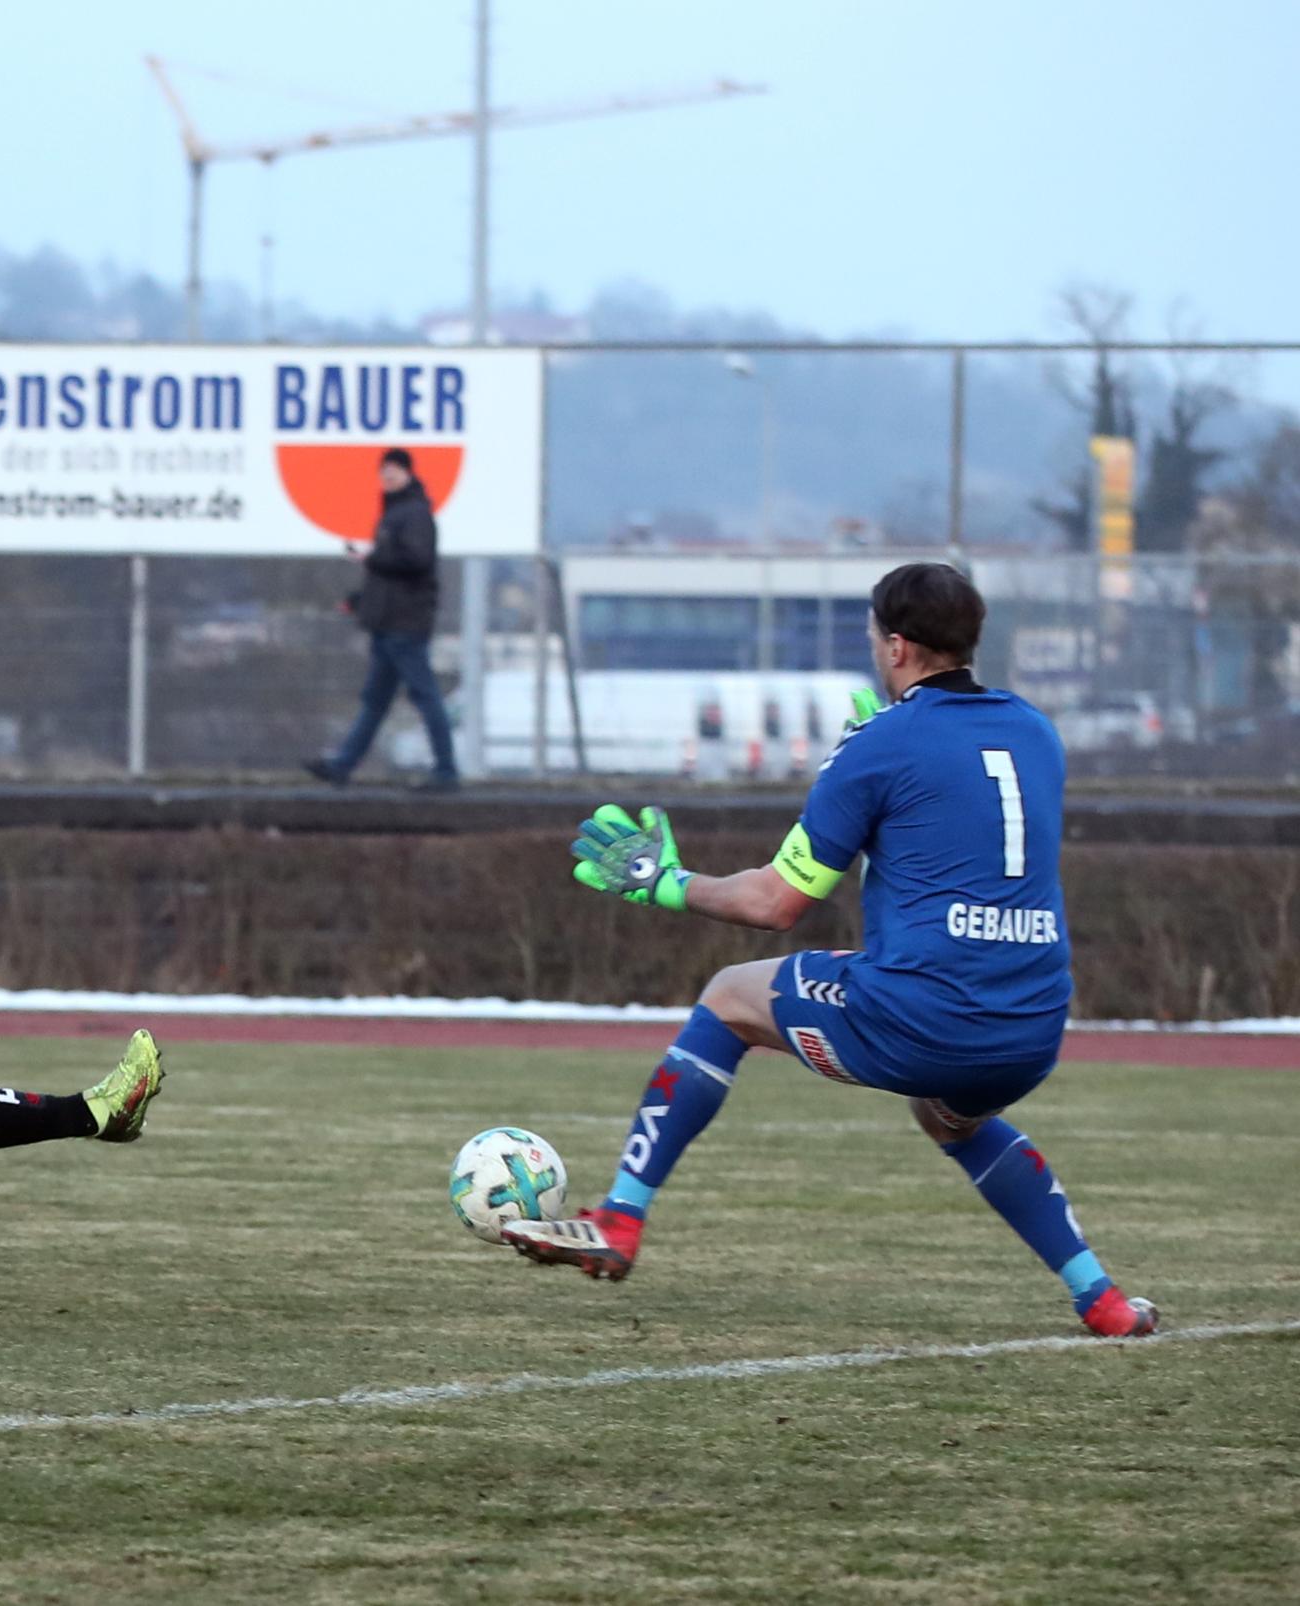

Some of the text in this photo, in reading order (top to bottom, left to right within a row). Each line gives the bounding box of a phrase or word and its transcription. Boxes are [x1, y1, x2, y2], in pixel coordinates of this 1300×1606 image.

[276, 365, 465, 431] BAUER
[2, 441, 48, 471] der
[60, 445, 119, 473] sich
[131, 444, 244, 474] rechnet
[981, 750, 1026, 877] 1
[946, 902, 1060, 944] GEBAUER
